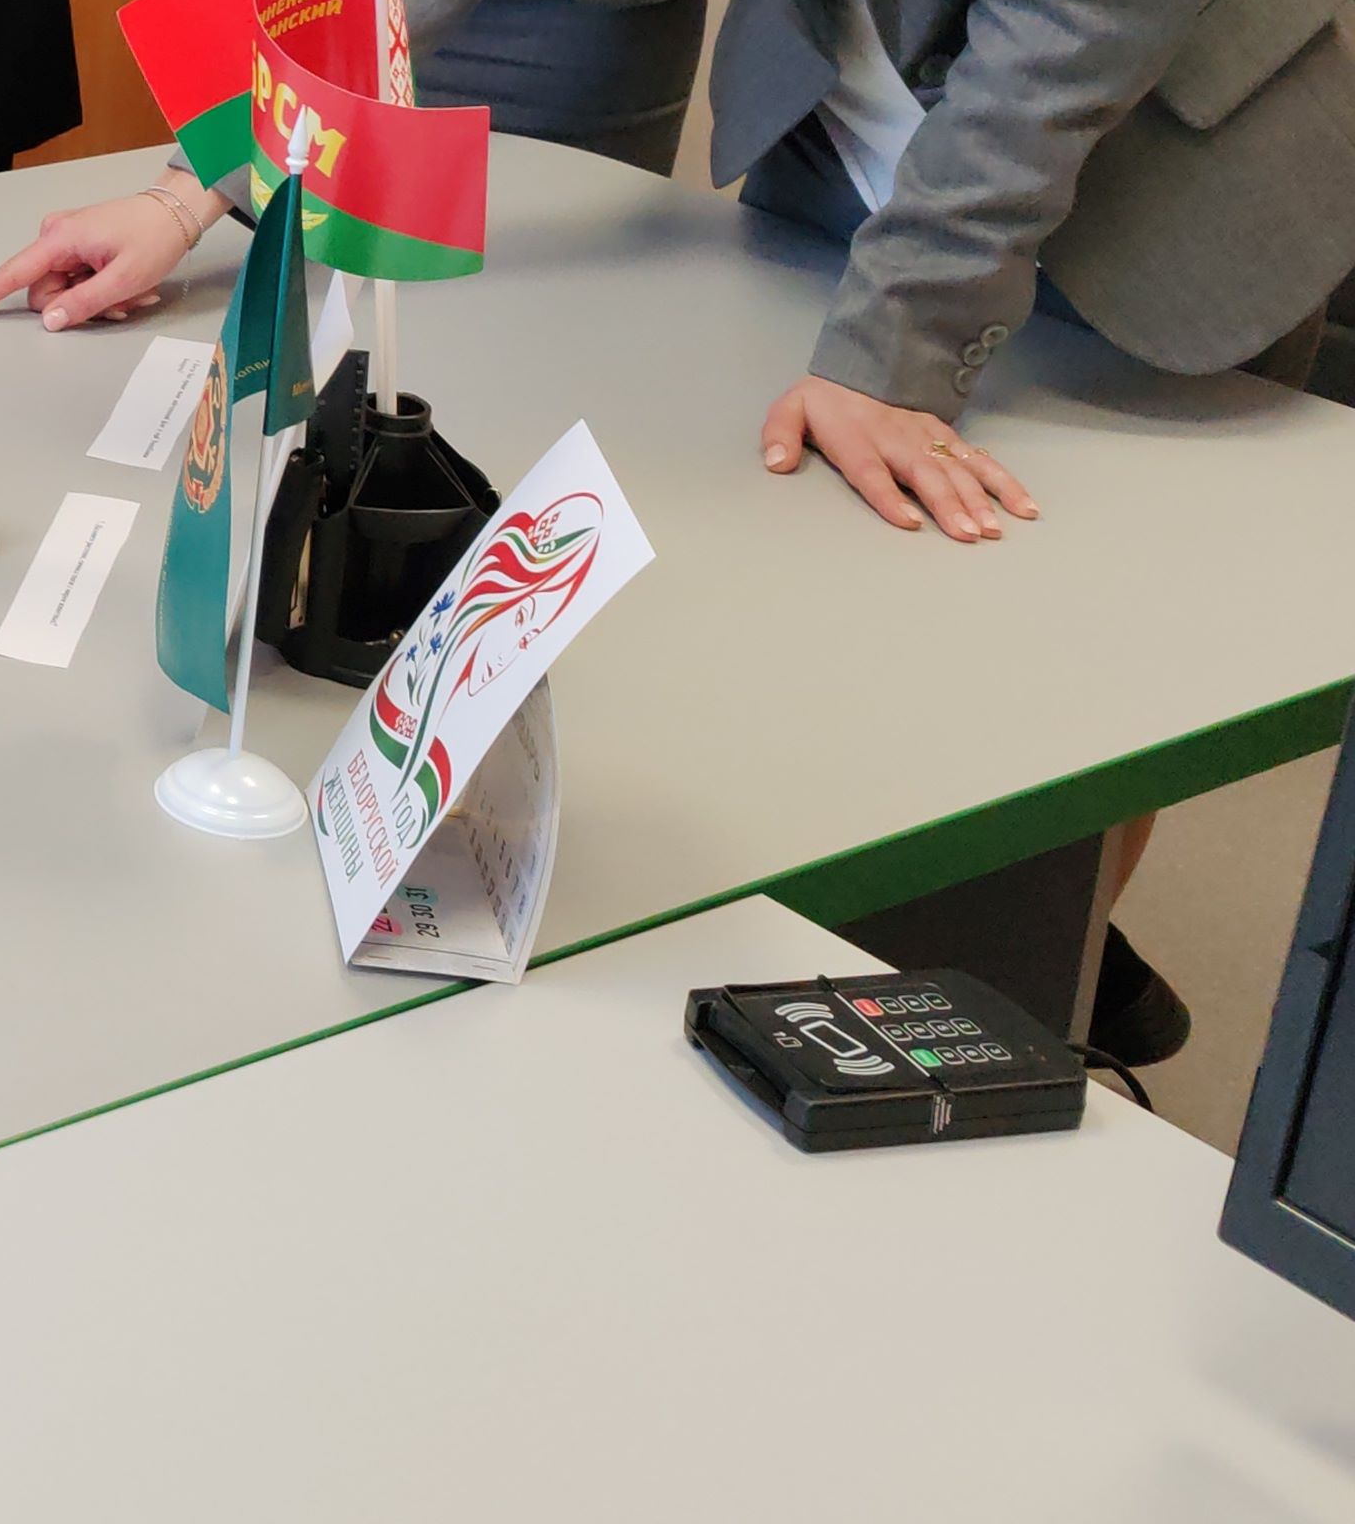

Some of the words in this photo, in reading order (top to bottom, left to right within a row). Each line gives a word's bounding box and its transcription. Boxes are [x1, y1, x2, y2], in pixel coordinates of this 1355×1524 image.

[324, 767, 364, 883] ЖЕНЩИНЫ
[347, 748, 400, 889] БЕЛОРУССКОЙ
[393, 795, 415, 849] ГОД
[405, 887, 429, 900] 31
[409, 904, 435, 919] 30
[415, 923, 440, 938] 29
